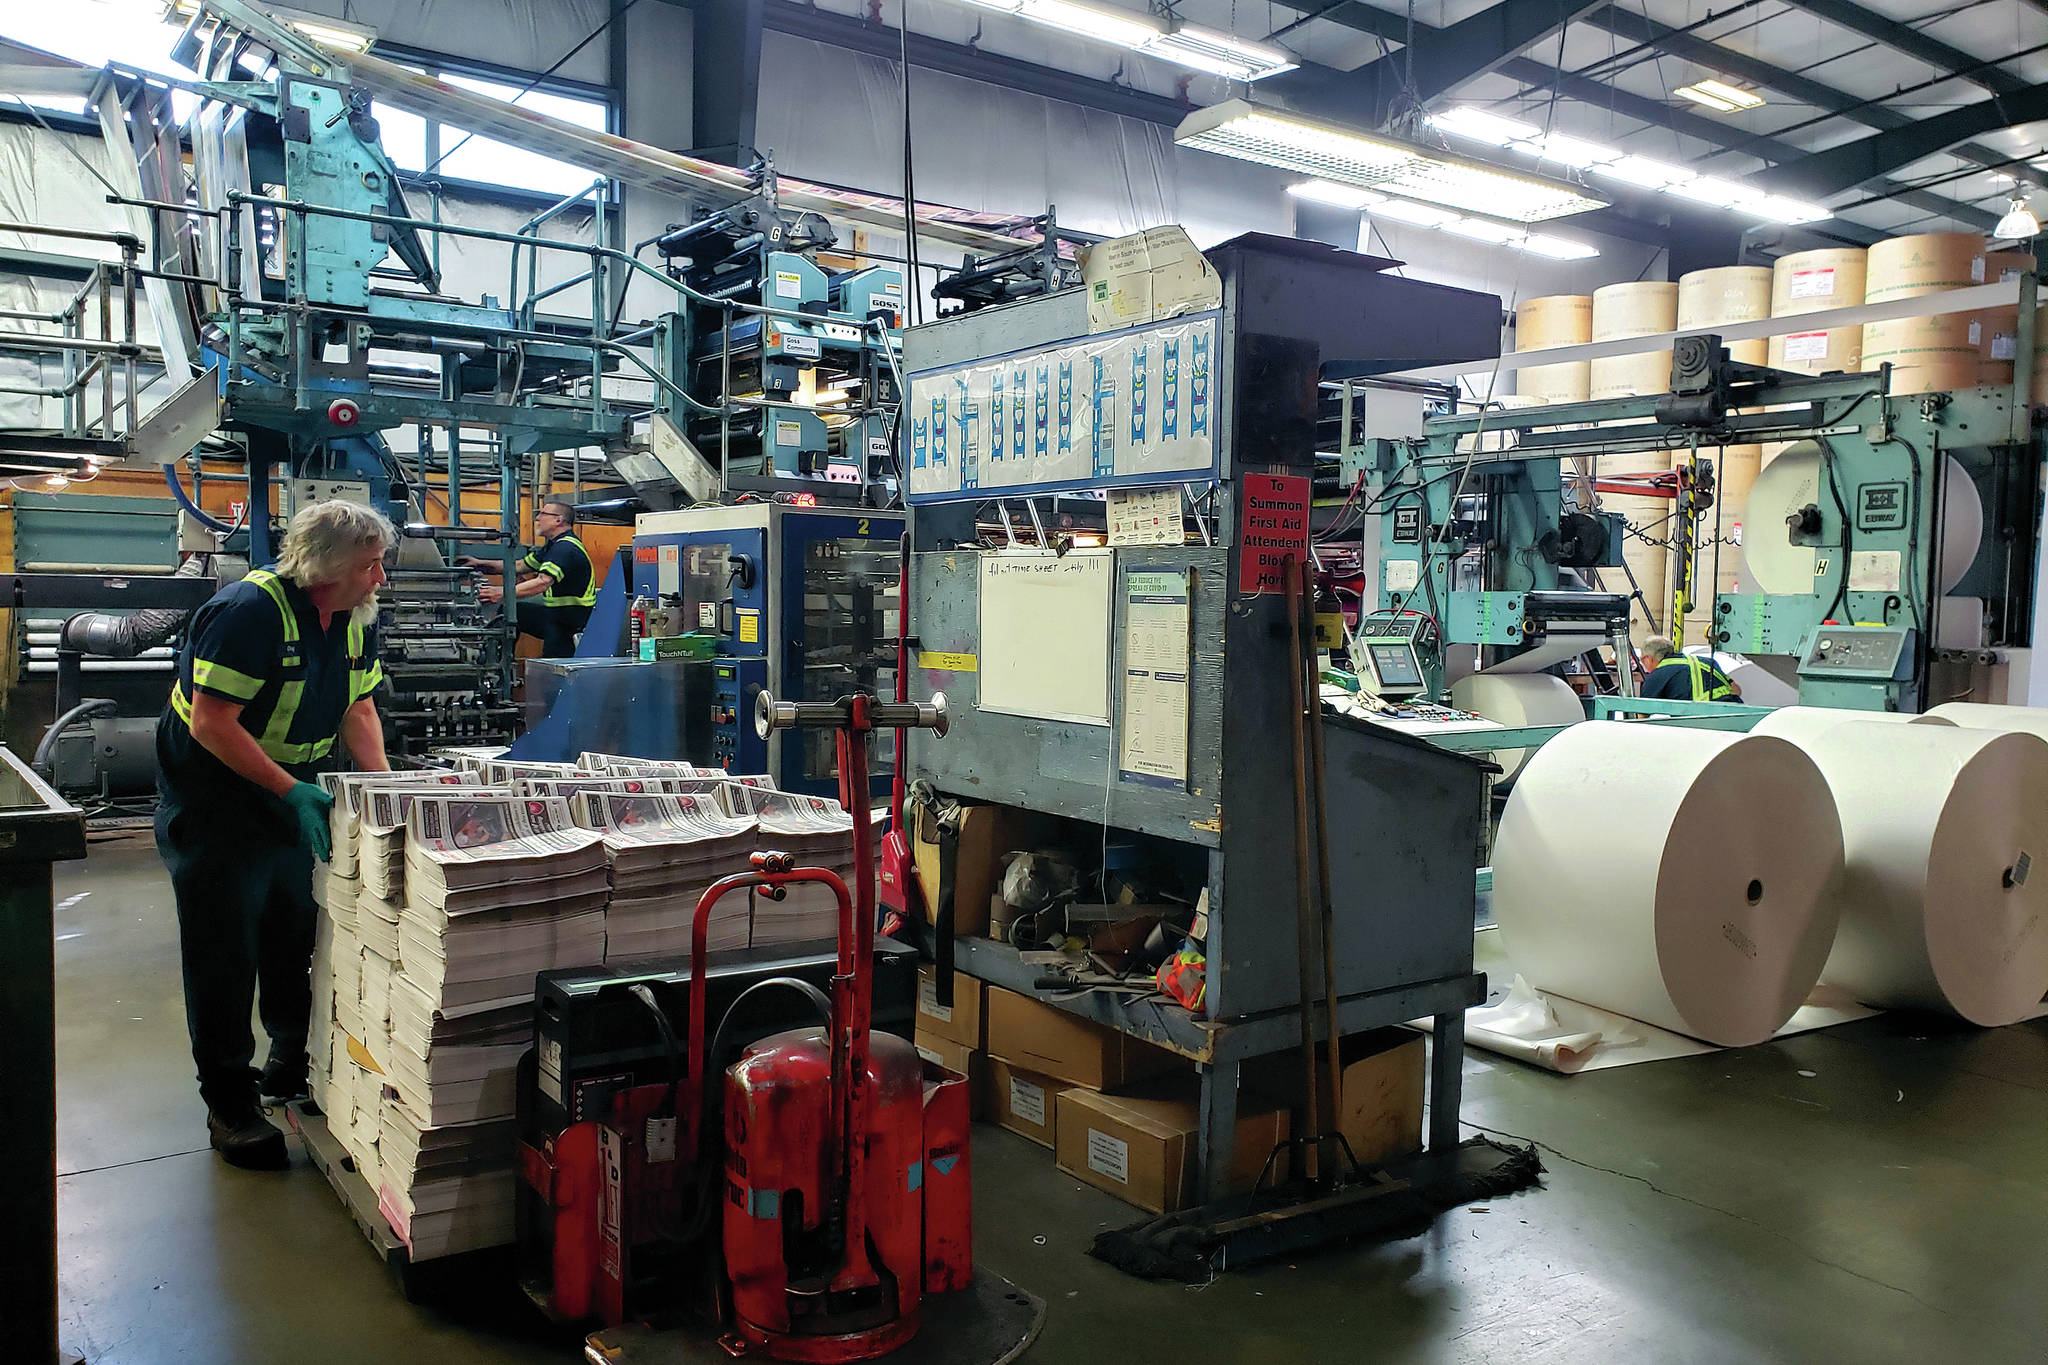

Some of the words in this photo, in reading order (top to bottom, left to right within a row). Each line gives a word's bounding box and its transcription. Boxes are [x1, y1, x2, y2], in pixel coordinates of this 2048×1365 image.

[772, 228, 780, 240] G
[1052, 275, 1059, 286] H
[872, 299, 899, 309] GOSS
[786, 337, 801, 345] Goss
[786, 344, 816, 354] Community
[774, 380, 781, 389] 3
[1269, 479, 1284, 491] To
[1249, 496, 1302, 511] Summon
[858, 518, 869, 535] 2
[1249, 515, 1277, 529] First
[1282, 518, 1301, 530] Aid
[1244, 535, 1305, 549] Attendent
[1437, 562, 1445, 574] G
[1816, 560, 1828, 575] H
[658, 650, 694, 658] TouchNTuff
